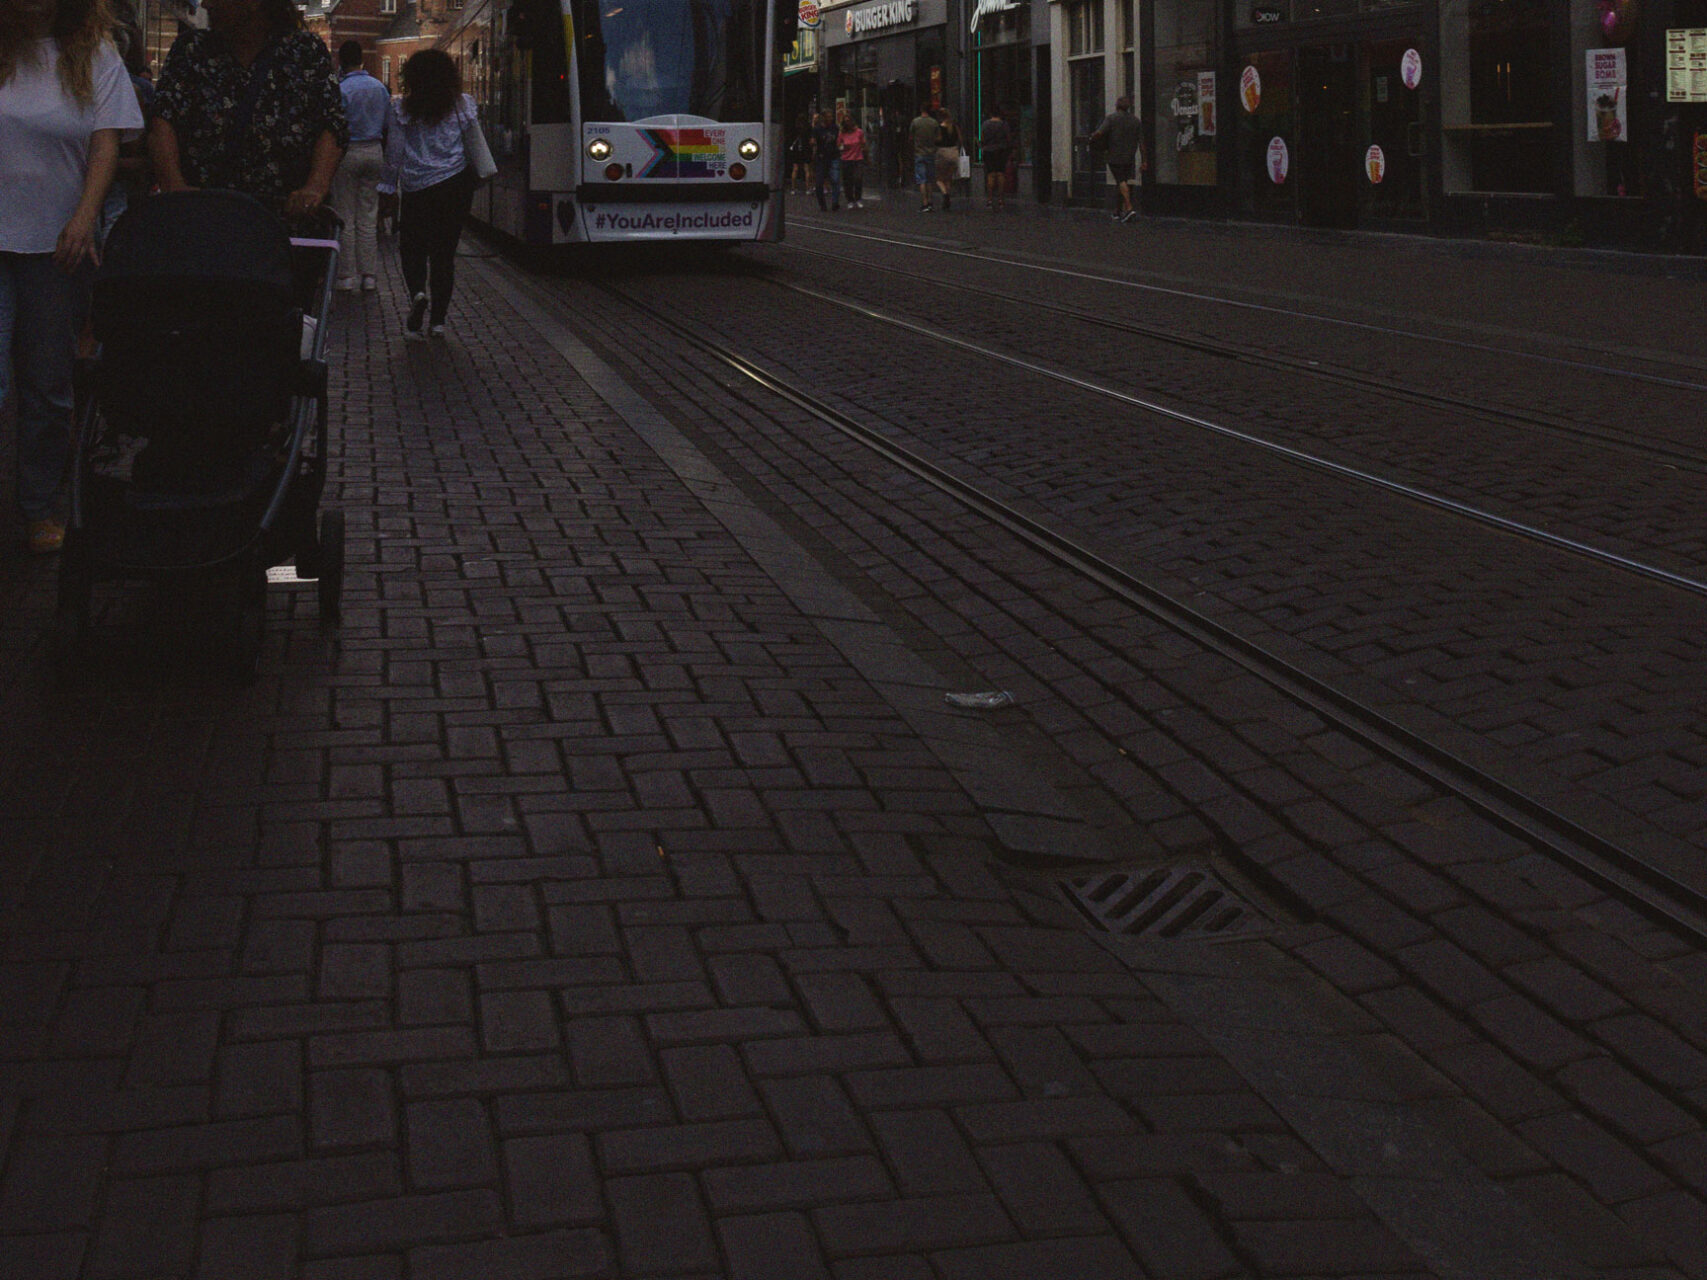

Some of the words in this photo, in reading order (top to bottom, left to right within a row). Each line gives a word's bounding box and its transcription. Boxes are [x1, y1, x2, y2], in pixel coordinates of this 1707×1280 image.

[801, 9, 819, 20] KING
[855, 4, 888, 32] BURGER
[704, 129, 726, 137] EVERY
[708, 161, 727, 170] HERE
[596, 211, 753, 230] #YouAreIncluded
